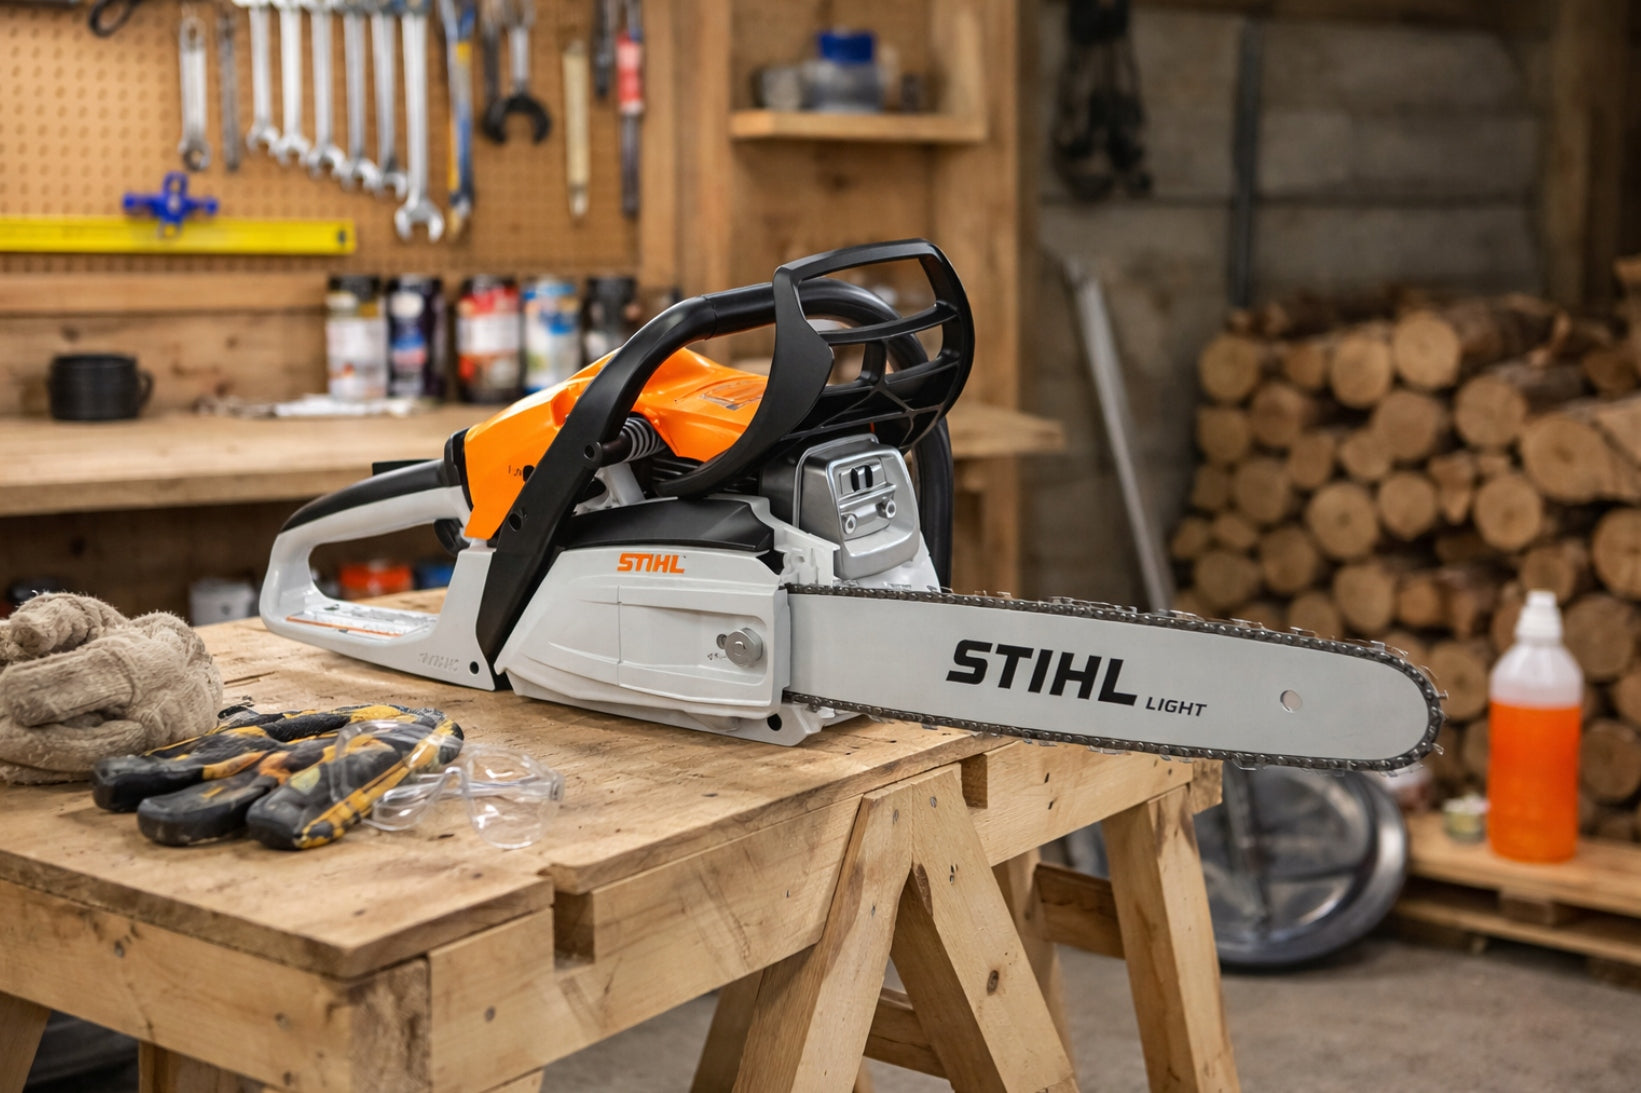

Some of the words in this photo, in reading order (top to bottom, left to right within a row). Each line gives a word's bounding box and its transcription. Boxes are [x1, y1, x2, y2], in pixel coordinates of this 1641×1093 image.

[617, 553, 685, 574] STIHL
[946, 639, 1138, 706] STIHL
[1145, 696, 1207, 717] LIGHT
